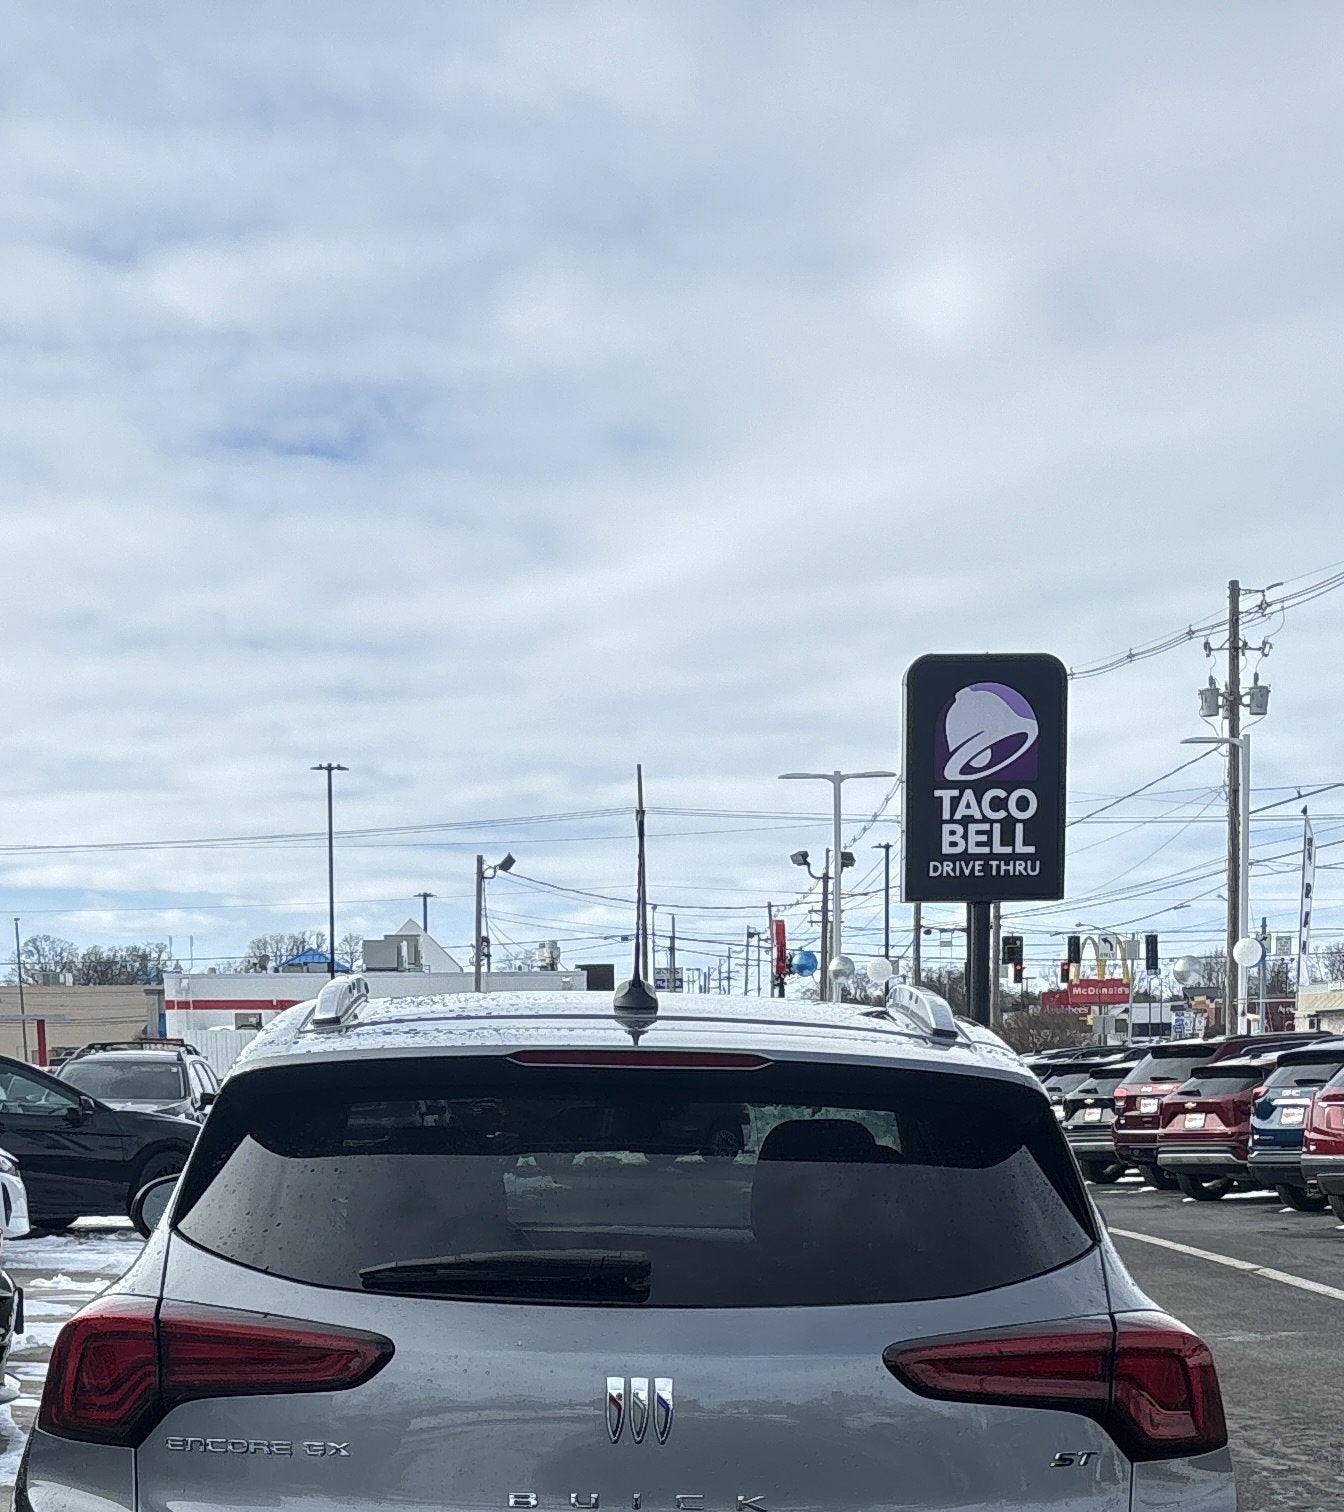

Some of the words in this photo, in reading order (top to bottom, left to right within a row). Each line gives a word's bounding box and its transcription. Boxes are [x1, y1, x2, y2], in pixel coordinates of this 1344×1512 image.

[934, 788, 1038, 820] TACO
[941, 823, 1036, 854] BELL
[929, 861, 985, 877] DRIVE
[989, 860, 1041, 876] THRU
[1072, 986, 1130, 996] McDonald's
[166, 1436, 294, 1457] ENCORE
[303, 1441, 352, 1457] GX
[1049, 1450, 1100, 1467] ST
[508, 1492, 768, 1512] BUICK
